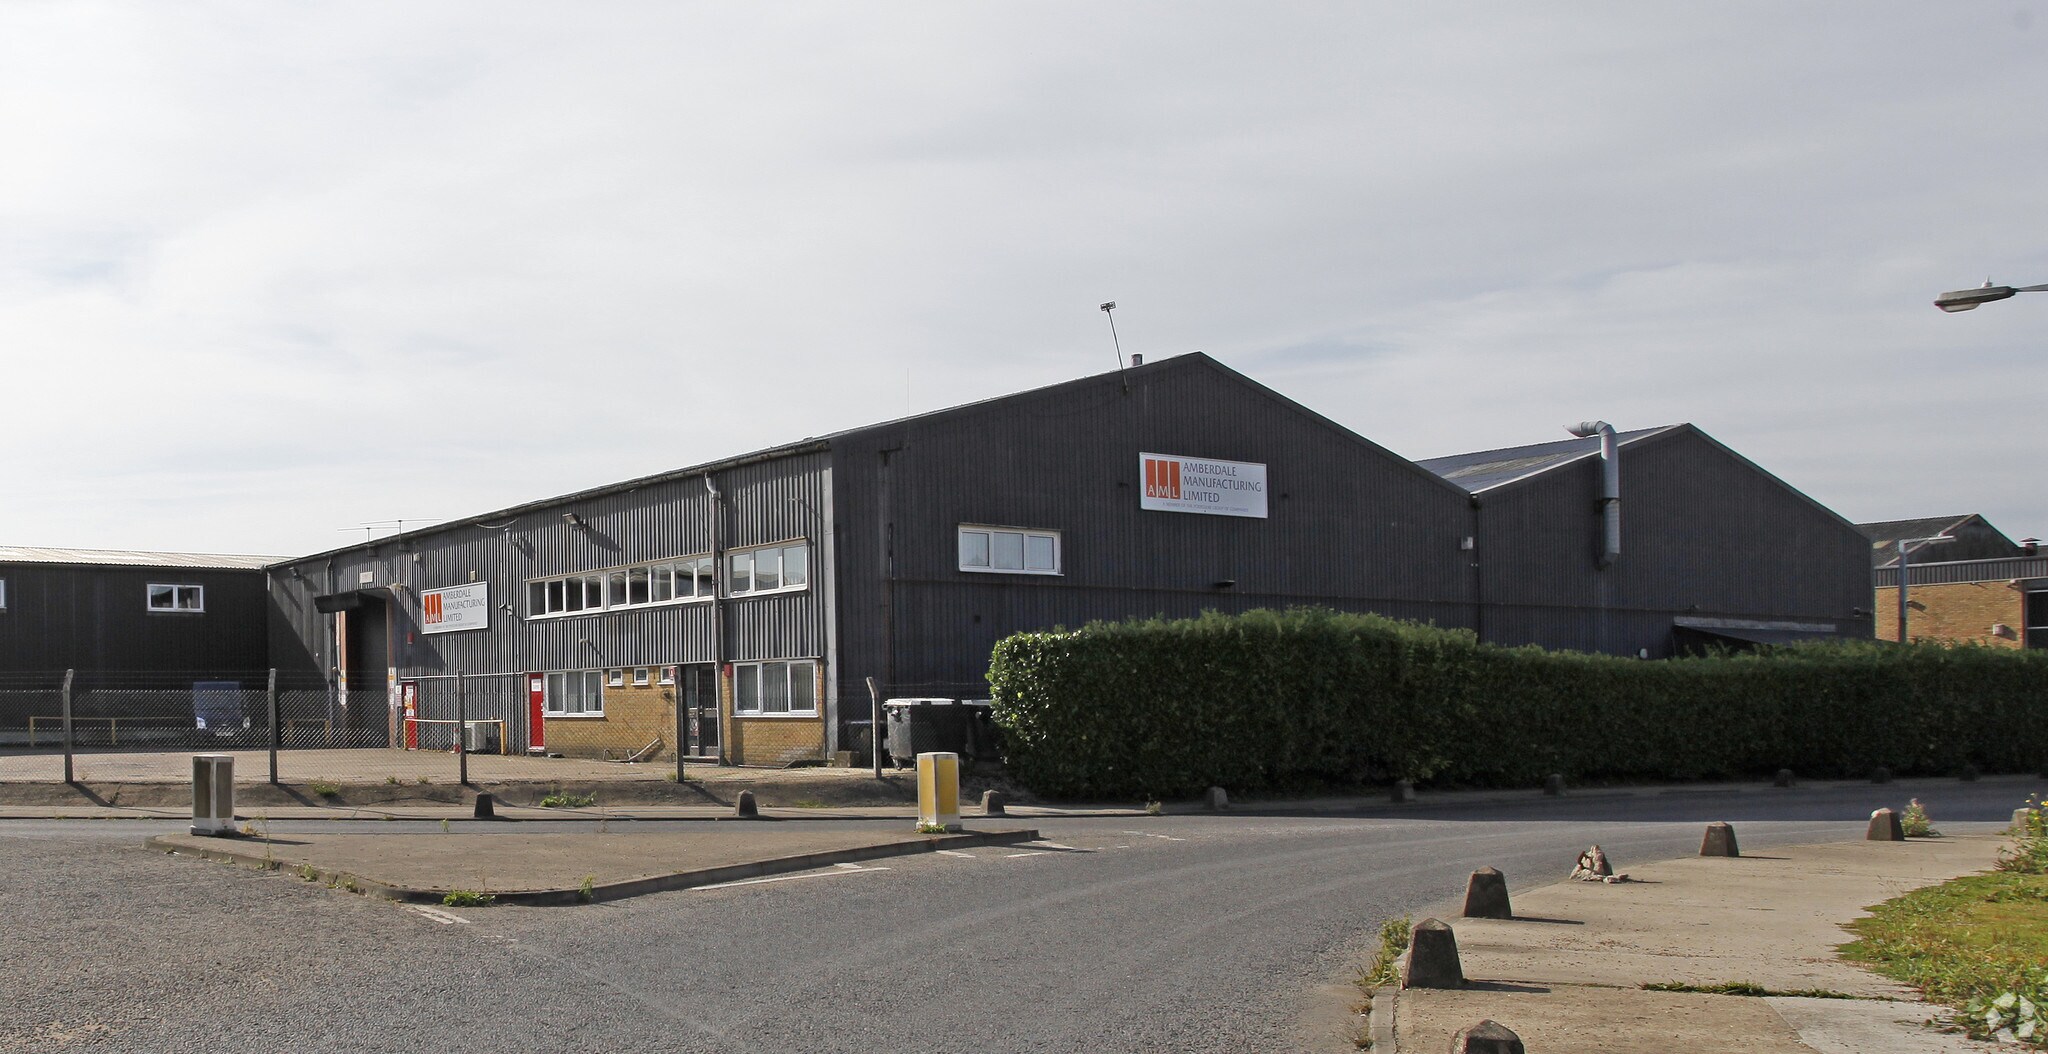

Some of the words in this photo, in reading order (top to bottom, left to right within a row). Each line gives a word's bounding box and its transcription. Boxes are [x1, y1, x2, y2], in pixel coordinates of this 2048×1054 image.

[1182, 462, 1237, 477] AMBERDALE
[1183, 476, 1262, 492] MANUFACTURING
[1147, 484, 1178, 498] AML
[1183, 490, 1220, 503] LIMITED
[442, 588, 471, 600] AMBERDALE
[443, 598, 486, 611] MANUFACTURING
[443, 612, 463, 623] LIMITED
